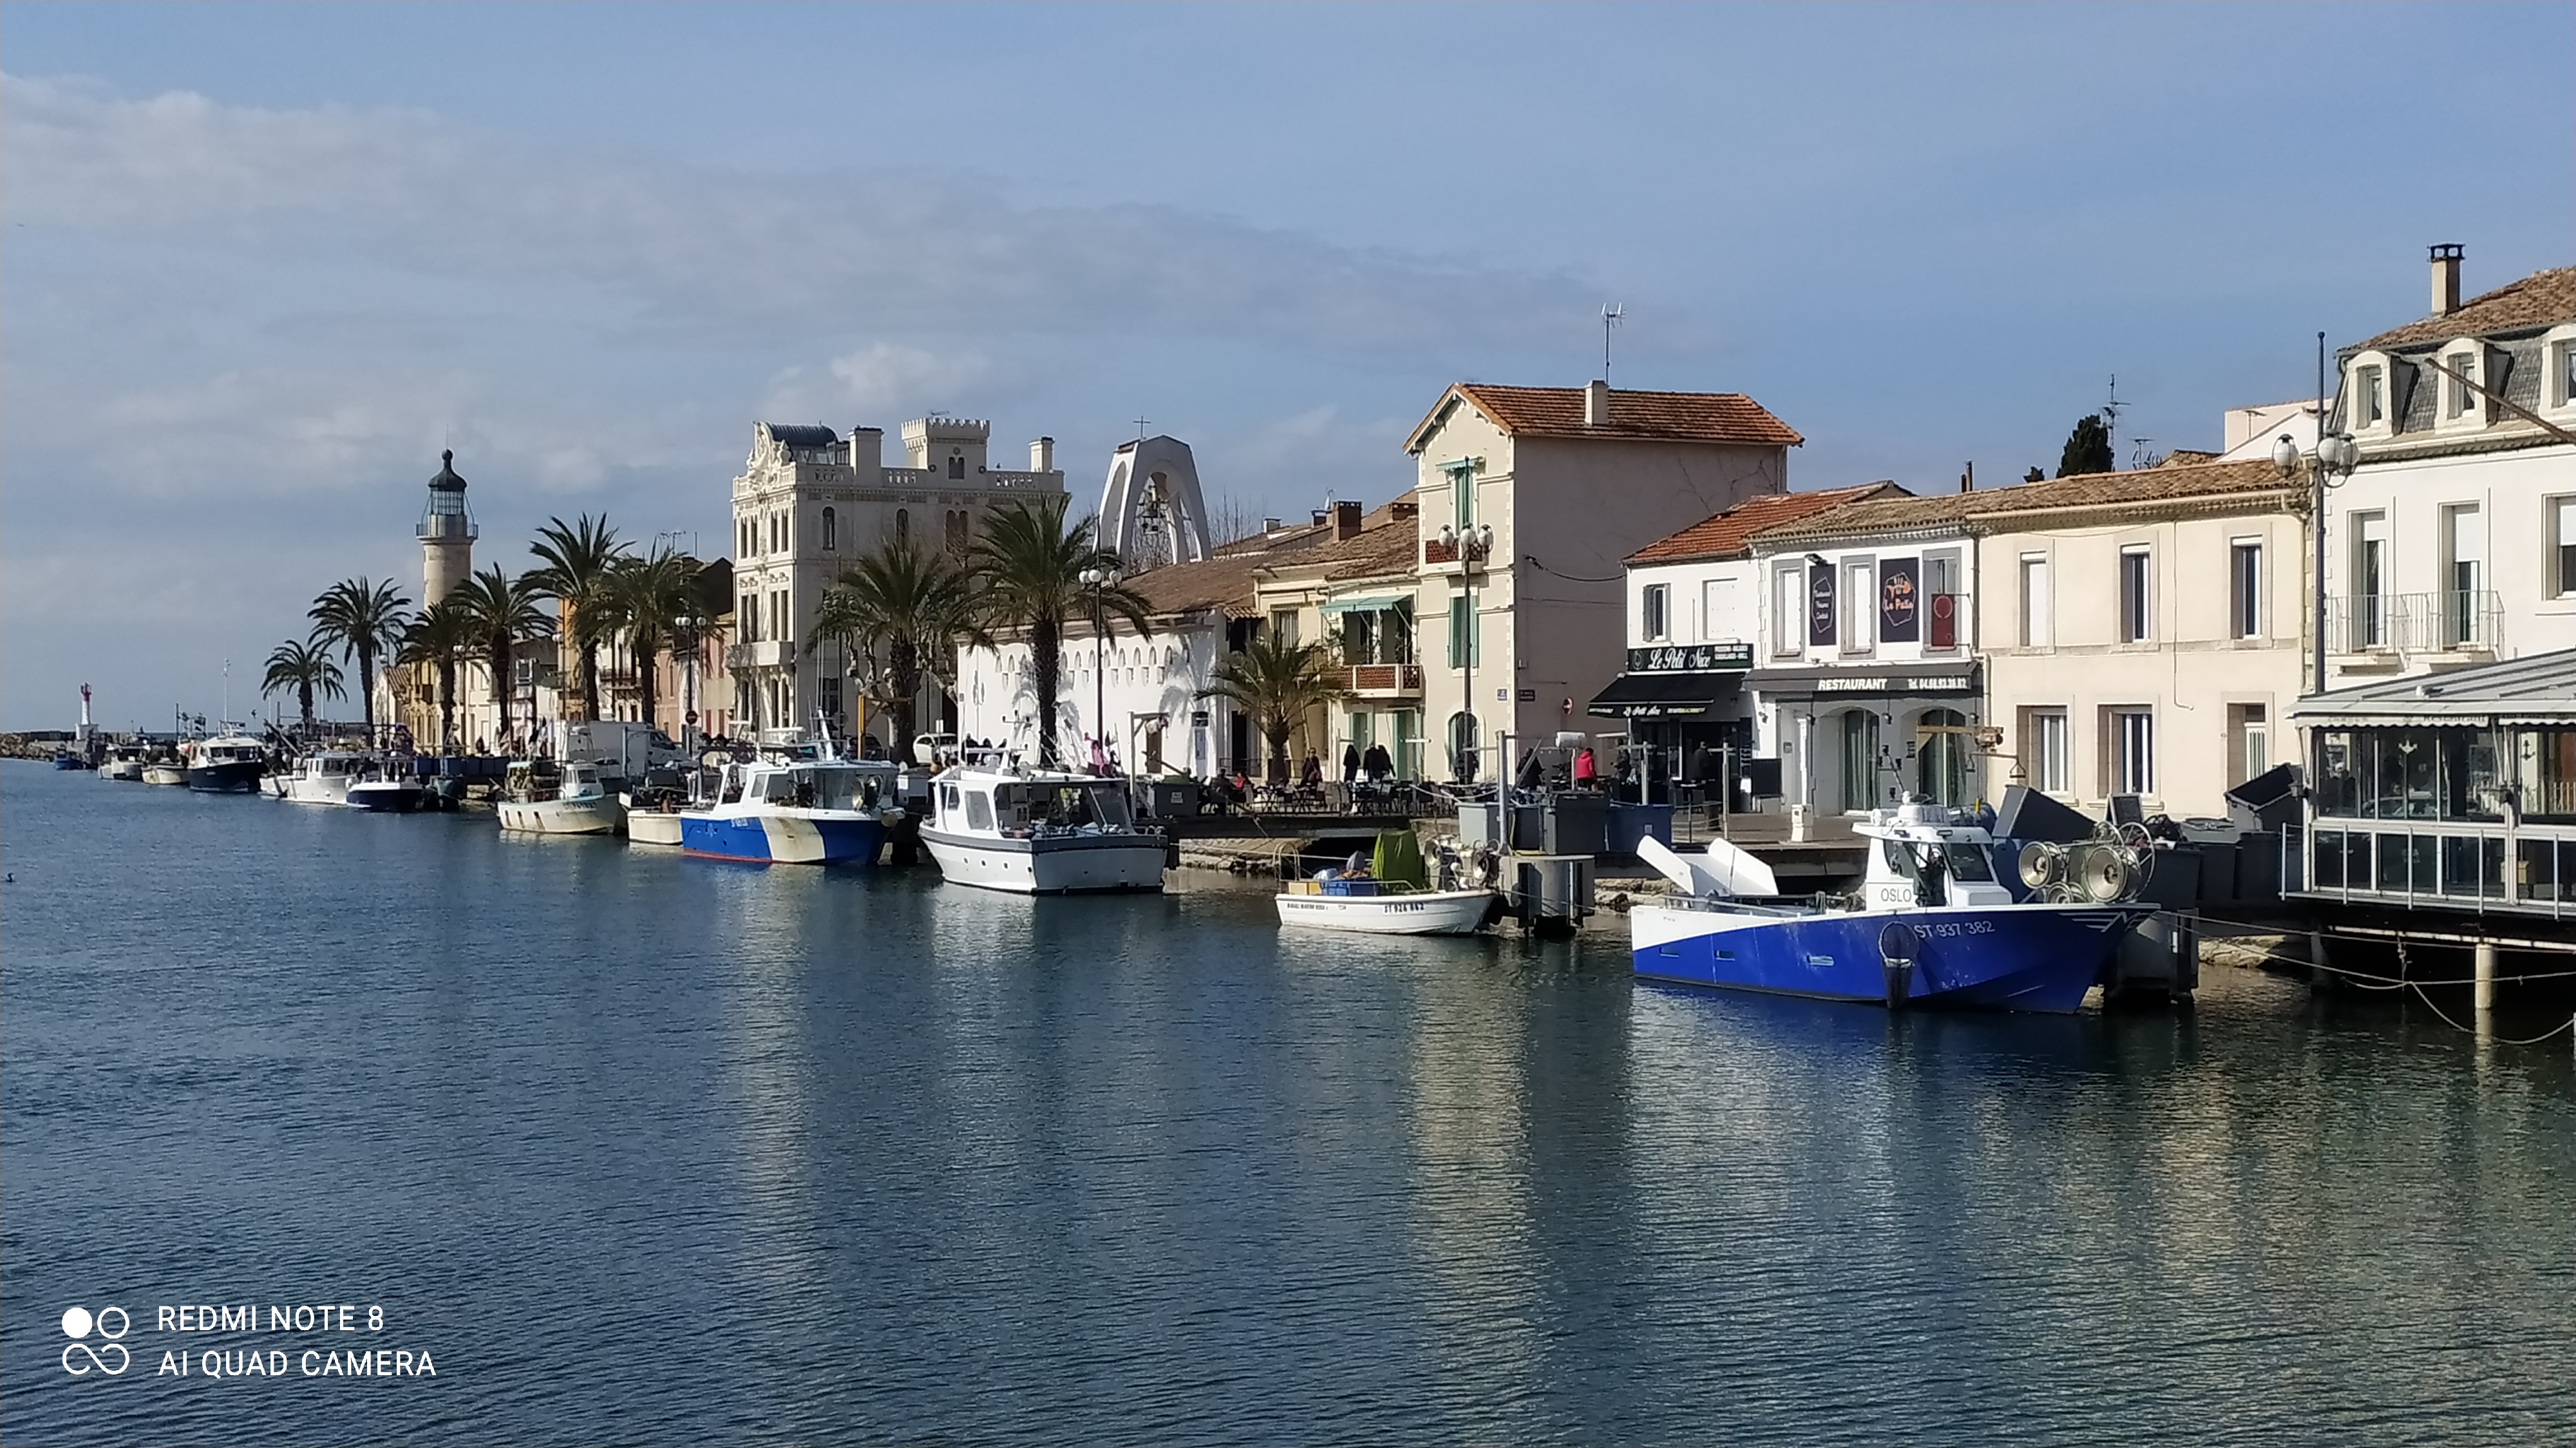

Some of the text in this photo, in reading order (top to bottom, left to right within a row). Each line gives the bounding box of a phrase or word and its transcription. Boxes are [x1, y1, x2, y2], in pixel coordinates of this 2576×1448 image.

[1648, 646, 1711, 670] Le Petit Nice
[1818, 678, 1888, 691] RESTAURANT
[1880, 888, 1912, 902] OSLO
[1913, 920, 1996, 938] ST 937 382
